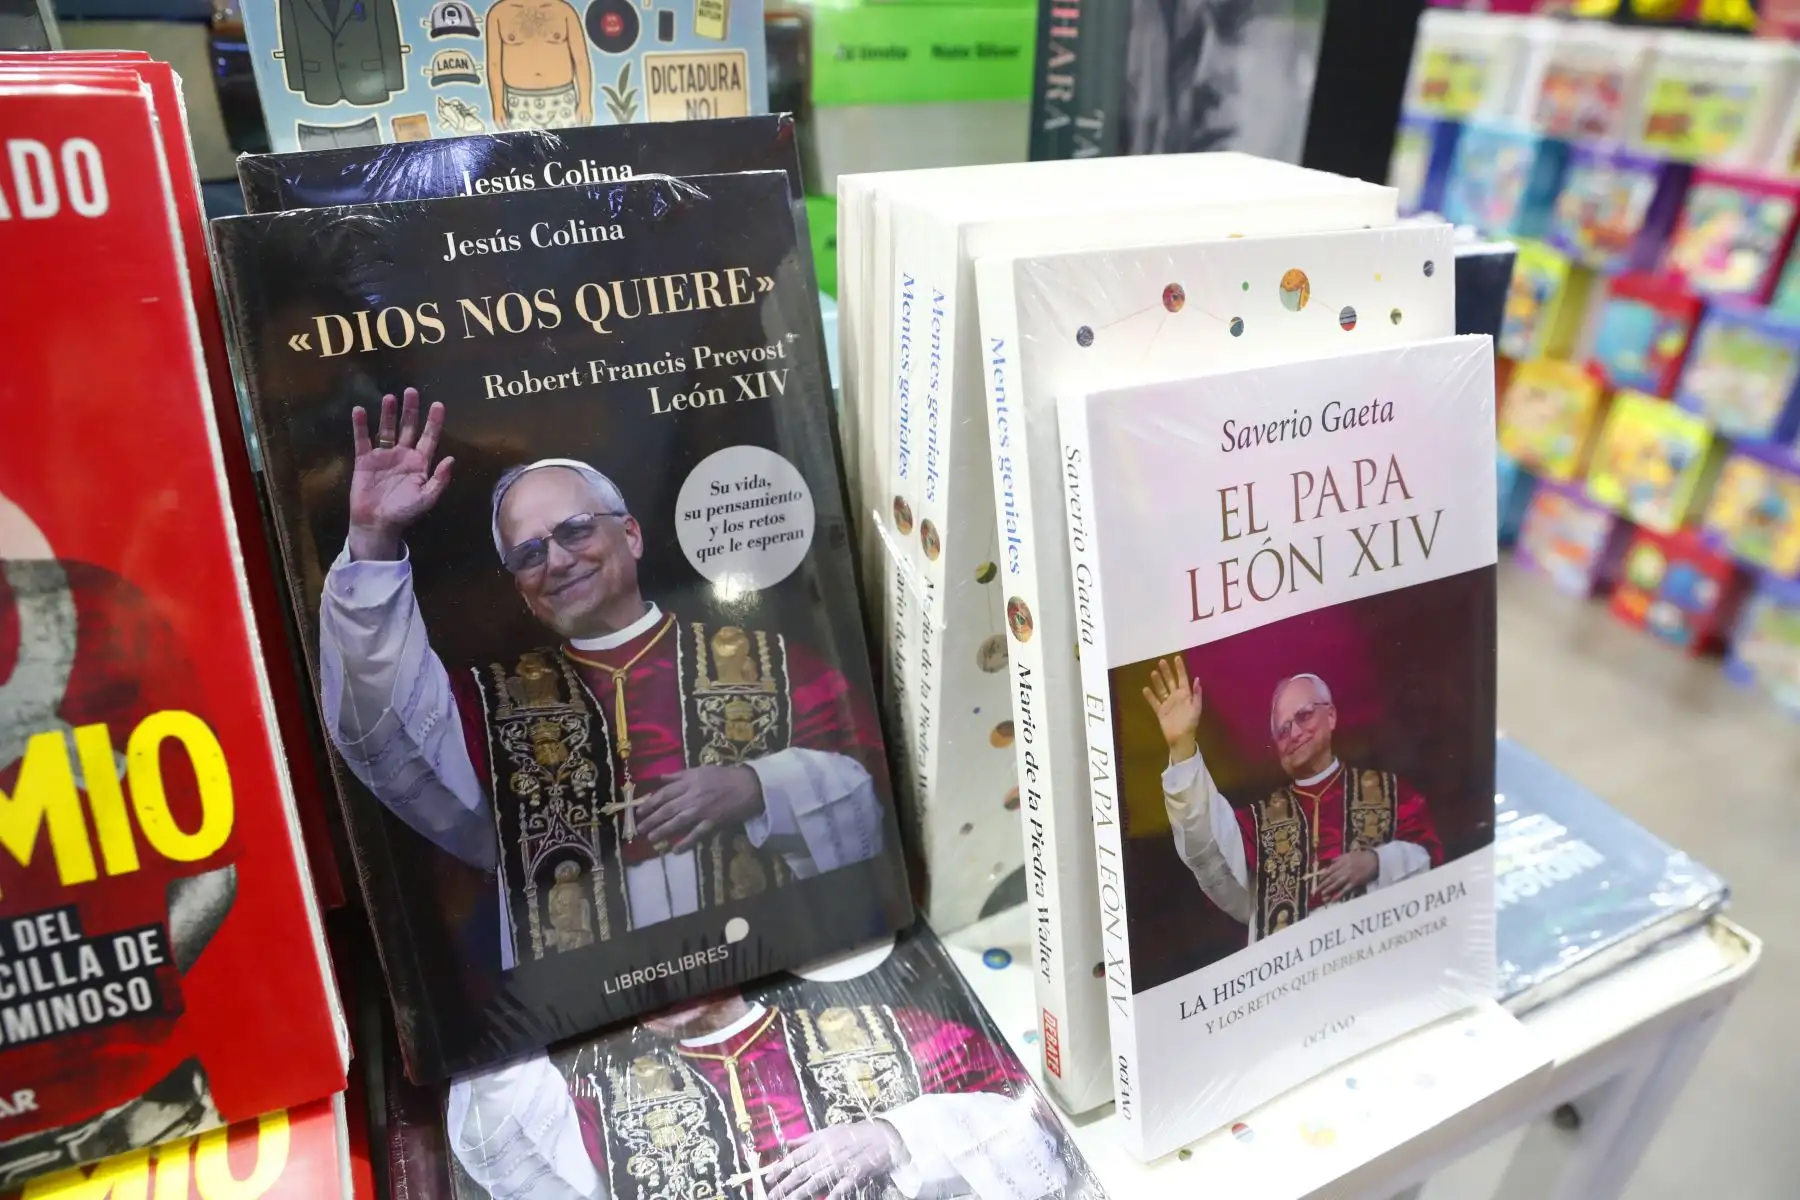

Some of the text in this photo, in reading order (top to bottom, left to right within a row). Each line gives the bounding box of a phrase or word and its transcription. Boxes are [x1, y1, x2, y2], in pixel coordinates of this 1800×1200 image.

[436, 58, 469, 71] LACAN
[651, 61, 742, 95] DICTADURA
[1044, 0, 1080, 130] HARA
[460, 159, 633, 197] Jesús Colina
[443, 217, 625, 262] Jesús Colina
[288, 266, 775, 358] «DIOS NOS QUIERE»
[483, 340, 787, 400] Robert Francis Prevost
[648, 368, 790, 415] León XIV
[898, 271, 915, 480] Mentes geniales
[926, 287, 946, 503] Mentes geniales
[1221, 398, 1394, 453] Saverio Gaeta
[990, 337, 1023, 576] Mentes geniales
[684, 489, 803, 522] su pensamiento
[710, 474, 772, 496] Su vida,
[1218, 453, 1414, 543] EL PAPA
[696, 528, 805, 563] que le esperan
[708, 512, 786, 542] y los retos
[1065, 445, 1094, 646] Saverio Gaeta
[1185, 509, 1445, 623] LEÓN XIV
[919, 680, 933, 699] la
[920, 648, 934, 677] de
[1018, 662, 1052, 985] Mario de la Piedra Walter
[1086, 693, 1129, 1018] EL PAPA LEÓN XIV
[13, 910, 81, 952] DEL
[113, 929, 163, 972] DE
[1180, 881, 1467, 1021] LA HISTORIA DEL NUEVO PAPA
[604, 944, 729, 995] LIBROSLIBRES
[1205, 1020, 1215, 1034] Y
[1218, 1007, 1245, 1030] LOS
[1247, 984, 1289, 1020] RETOS
[1291, 968, 1320, 993] QUE
[1377, 915, 1450, 956] AFRONTAR
[0, 976, 153, 1046] MINOSO
